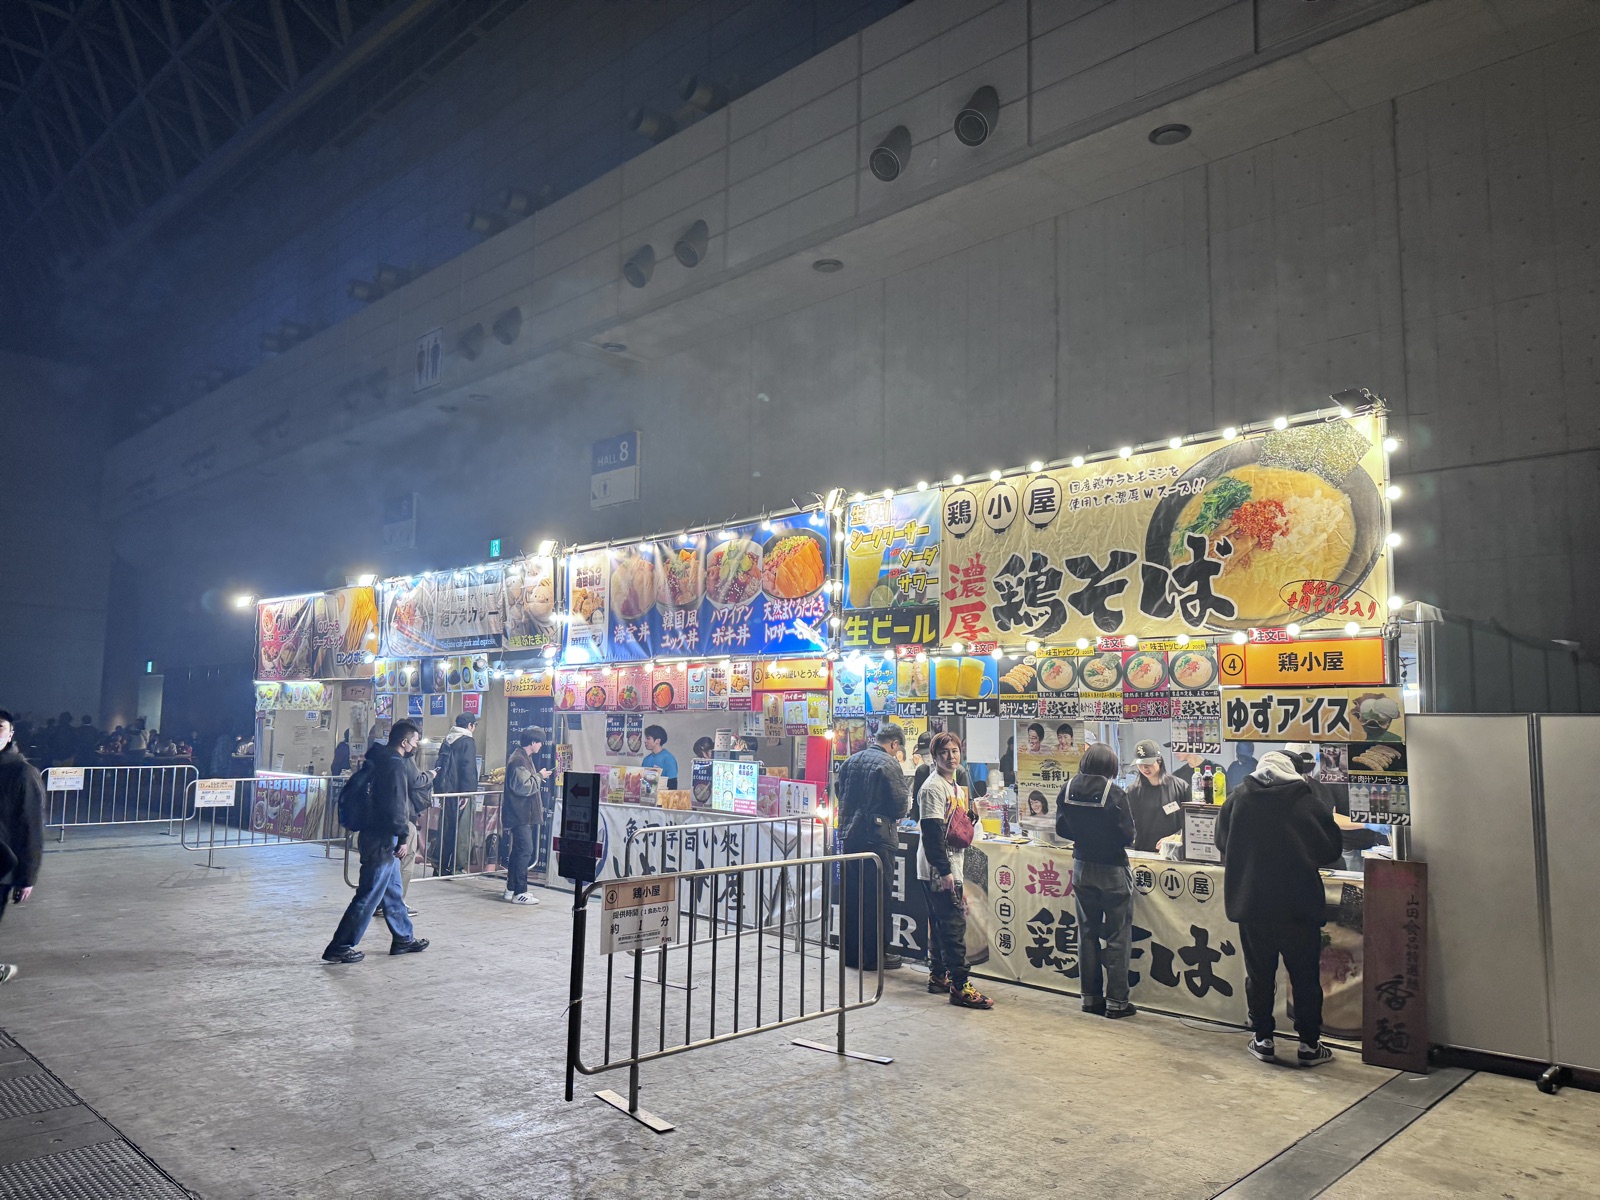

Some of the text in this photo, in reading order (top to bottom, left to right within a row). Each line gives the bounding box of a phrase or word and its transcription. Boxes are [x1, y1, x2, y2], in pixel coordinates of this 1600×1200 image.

[597, 441, 629, 466] HALL 8
[850, 519, 930, 551] シークワーサー
[899, 545, 939, 568] ソーダ
[898, 573, 939, 594] サワー
[992, 534, 1236, 638] 鶏そば
[943, 552, 990, 642] 濃厚
[661, 609, 699, 630] 韓国風
[710, 604, 753, 625] ハワイアン
[613, 624, 650, 644] 海宝丼
[660, 630, 699, 650] ユッケ丼
[712, 626, 750, 646] ポキ丼
[843, 614, 937, 646] 生ビール
[1255, 630, 1288, 642] 注文口
[1278, 651, 1344, 672] 鶏小屋
[898, 702, 928, 716] ハイボール
[938, 701, 991, 716] 生ビール
[1000, 701, 1037, 714] 肉汁ソーセージ
[1124, 704, 1138, 713] 辛口
[1227, 695, 1350, 734] ゆずアイス
[1172, 742, 1221, 754] ソフトドリンク
[1032, 770, 1070, 781] 一番搾り
[1320, 773, 1347, 781] アイスコーヒー
[1357, 775, 1405, 785] 肉汁ソーセージ
[1351, 810, 1410, 825] ソフトドリンク
[1025, 860, 1076, 899] 濃
[1135, 869, 1210, 896] 鶏小屋
[633, 884, 660, 899] 鶏小屋
[998, 870, 1013, 950] 鶏白湯
[660, 915, 669, 927] 分
